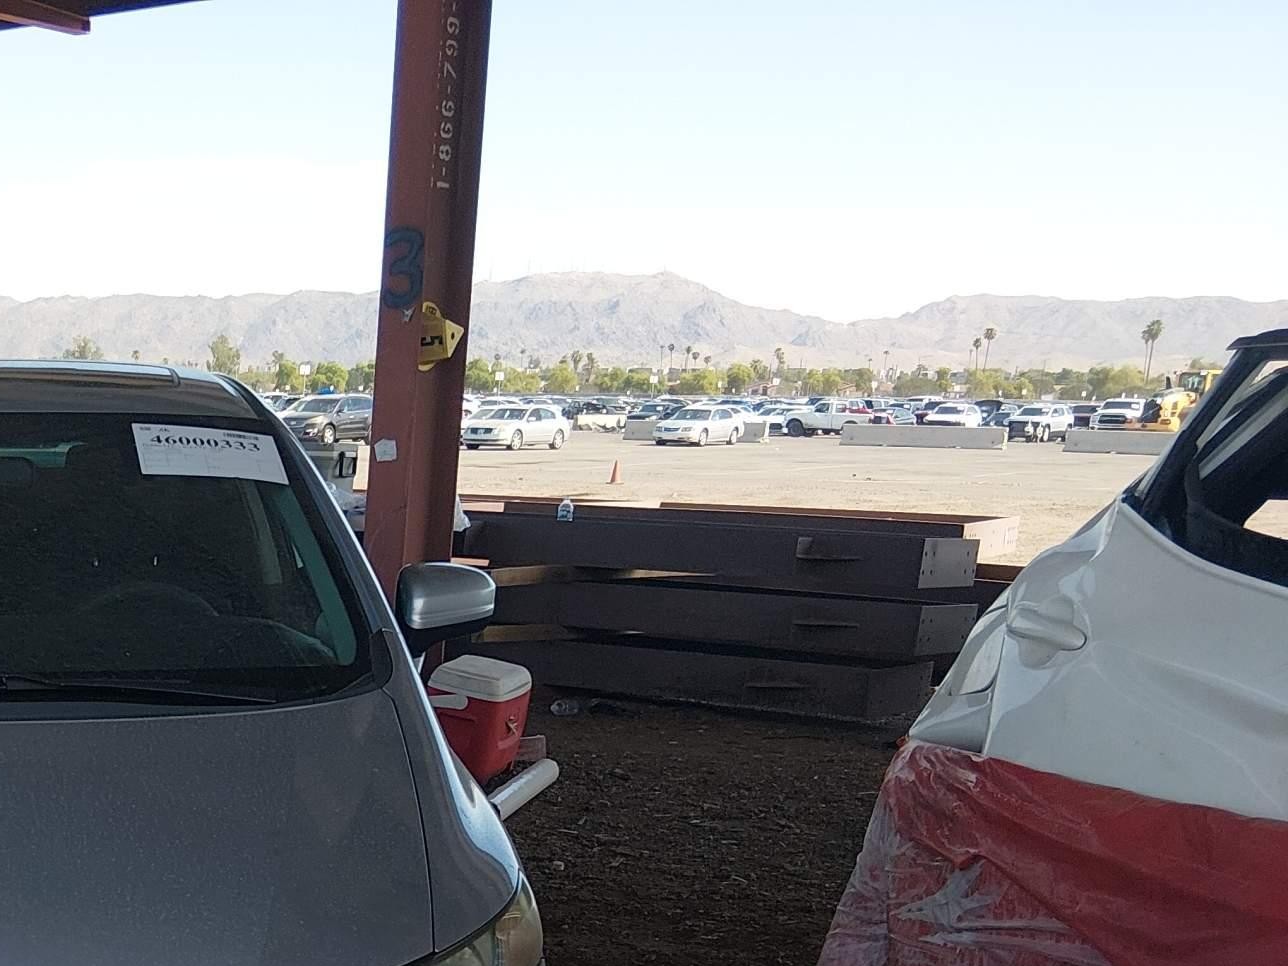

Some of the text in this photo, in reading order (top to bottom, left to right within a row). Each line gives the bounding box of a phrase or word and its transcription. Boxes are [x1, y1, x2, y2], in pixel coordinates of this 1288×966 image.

[383, 226, 424, 310] 3
[420, 335, 443, 347] 5
[150, 434, 261, 452] 46000333
